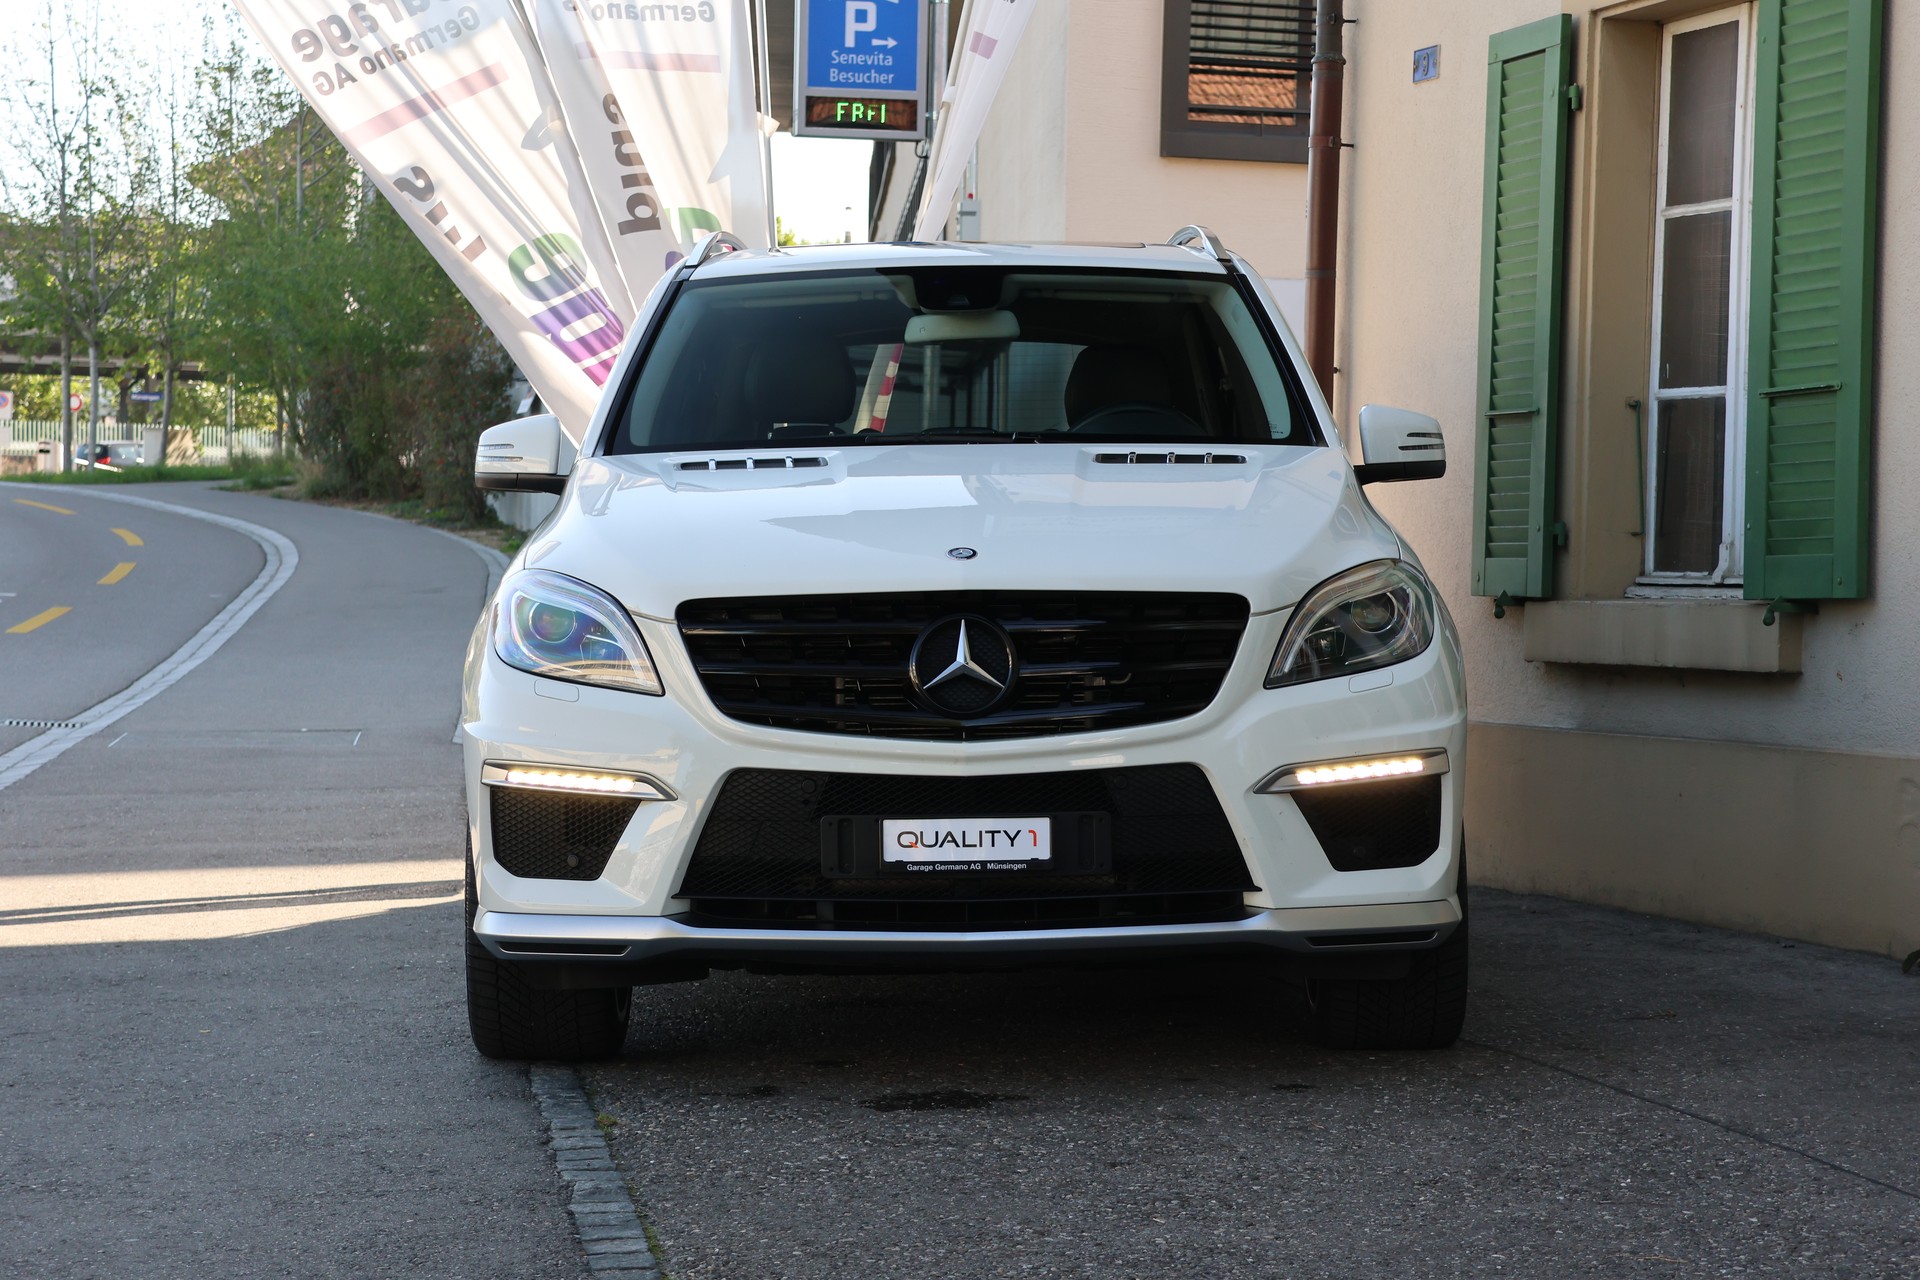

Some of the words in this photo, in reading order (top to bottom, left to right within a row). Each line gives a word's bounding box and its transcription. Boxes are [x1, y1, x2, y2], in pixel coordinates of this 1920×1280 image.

[844, 1, 877, 48] P
[831, 50, 893, 66] Senevita
[829, 68, 895, 84] Besucher
[897, 829, 1022, 849] QUALITY
[1028, 829, 1037, 847] 1
[906, 863, 934, 872] Garage
[935, 863, 969, 871] Germano
[970, 862, 981, 870] AG
[987, 862, 1027, 870] Münsingen
